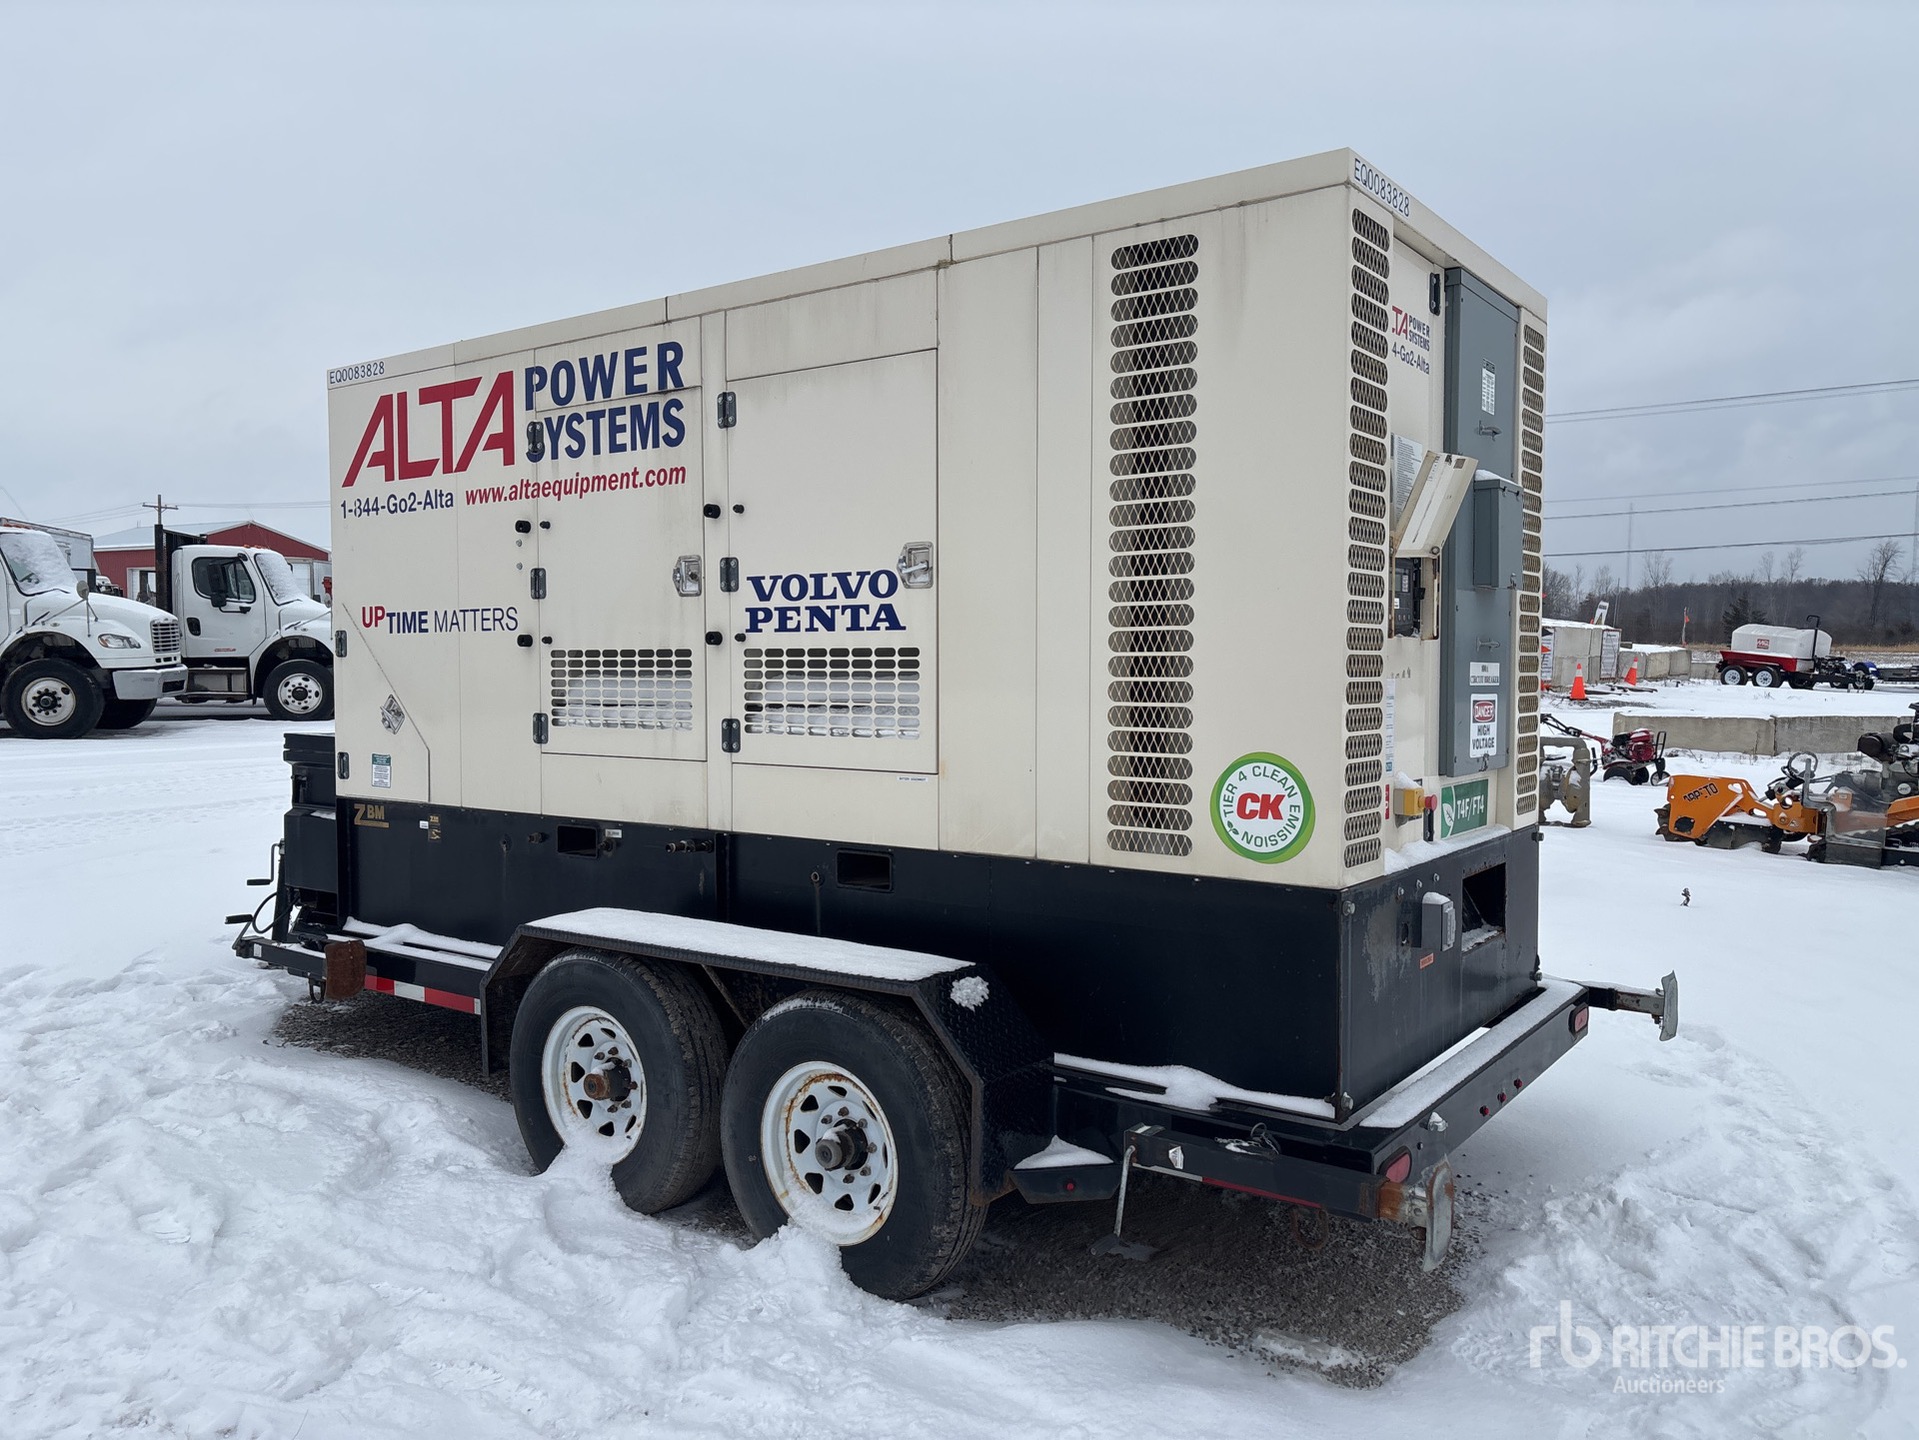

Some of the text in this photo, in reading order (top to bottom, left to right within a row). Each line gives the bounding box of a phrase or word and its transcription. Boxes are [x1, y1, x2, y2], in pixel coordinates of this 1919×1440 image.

[1354, 158, 1410, 218] EQ0083828
[1409, 315, 1430, 338] POWER
[1409, 330, 1430, 352] SYSTEMS
[330, 361, 385, 384] EQ0083828
[525, 341, 684, 411] POWER
[342, 371, 515, 488] ALTA
[526, 398, 686, 463] YSTEMS
[465, 466, 686, 506] www.altaequipment.com
[341, 489, 454, 519] 1-844-Go2-Alta
[746, 569, 898, 602] VOLVO
[434, 606, 518, 633] MATTERS
[745, 603, 906, 633] PENTA
[1474, 705, 1494, 718] DANGER
[1472, 737, 1495, 750] VOLTAGE
[1477, 724, 1490, 736] HIGH
[354, 804, 389, 829] ZBM
[1223, 765, 1300, 848] TIER 4 CLEAN EMISSION
[1236, 792, 1286, 820] CK
[1457, 795, 1484, 821] T4F/FT4
